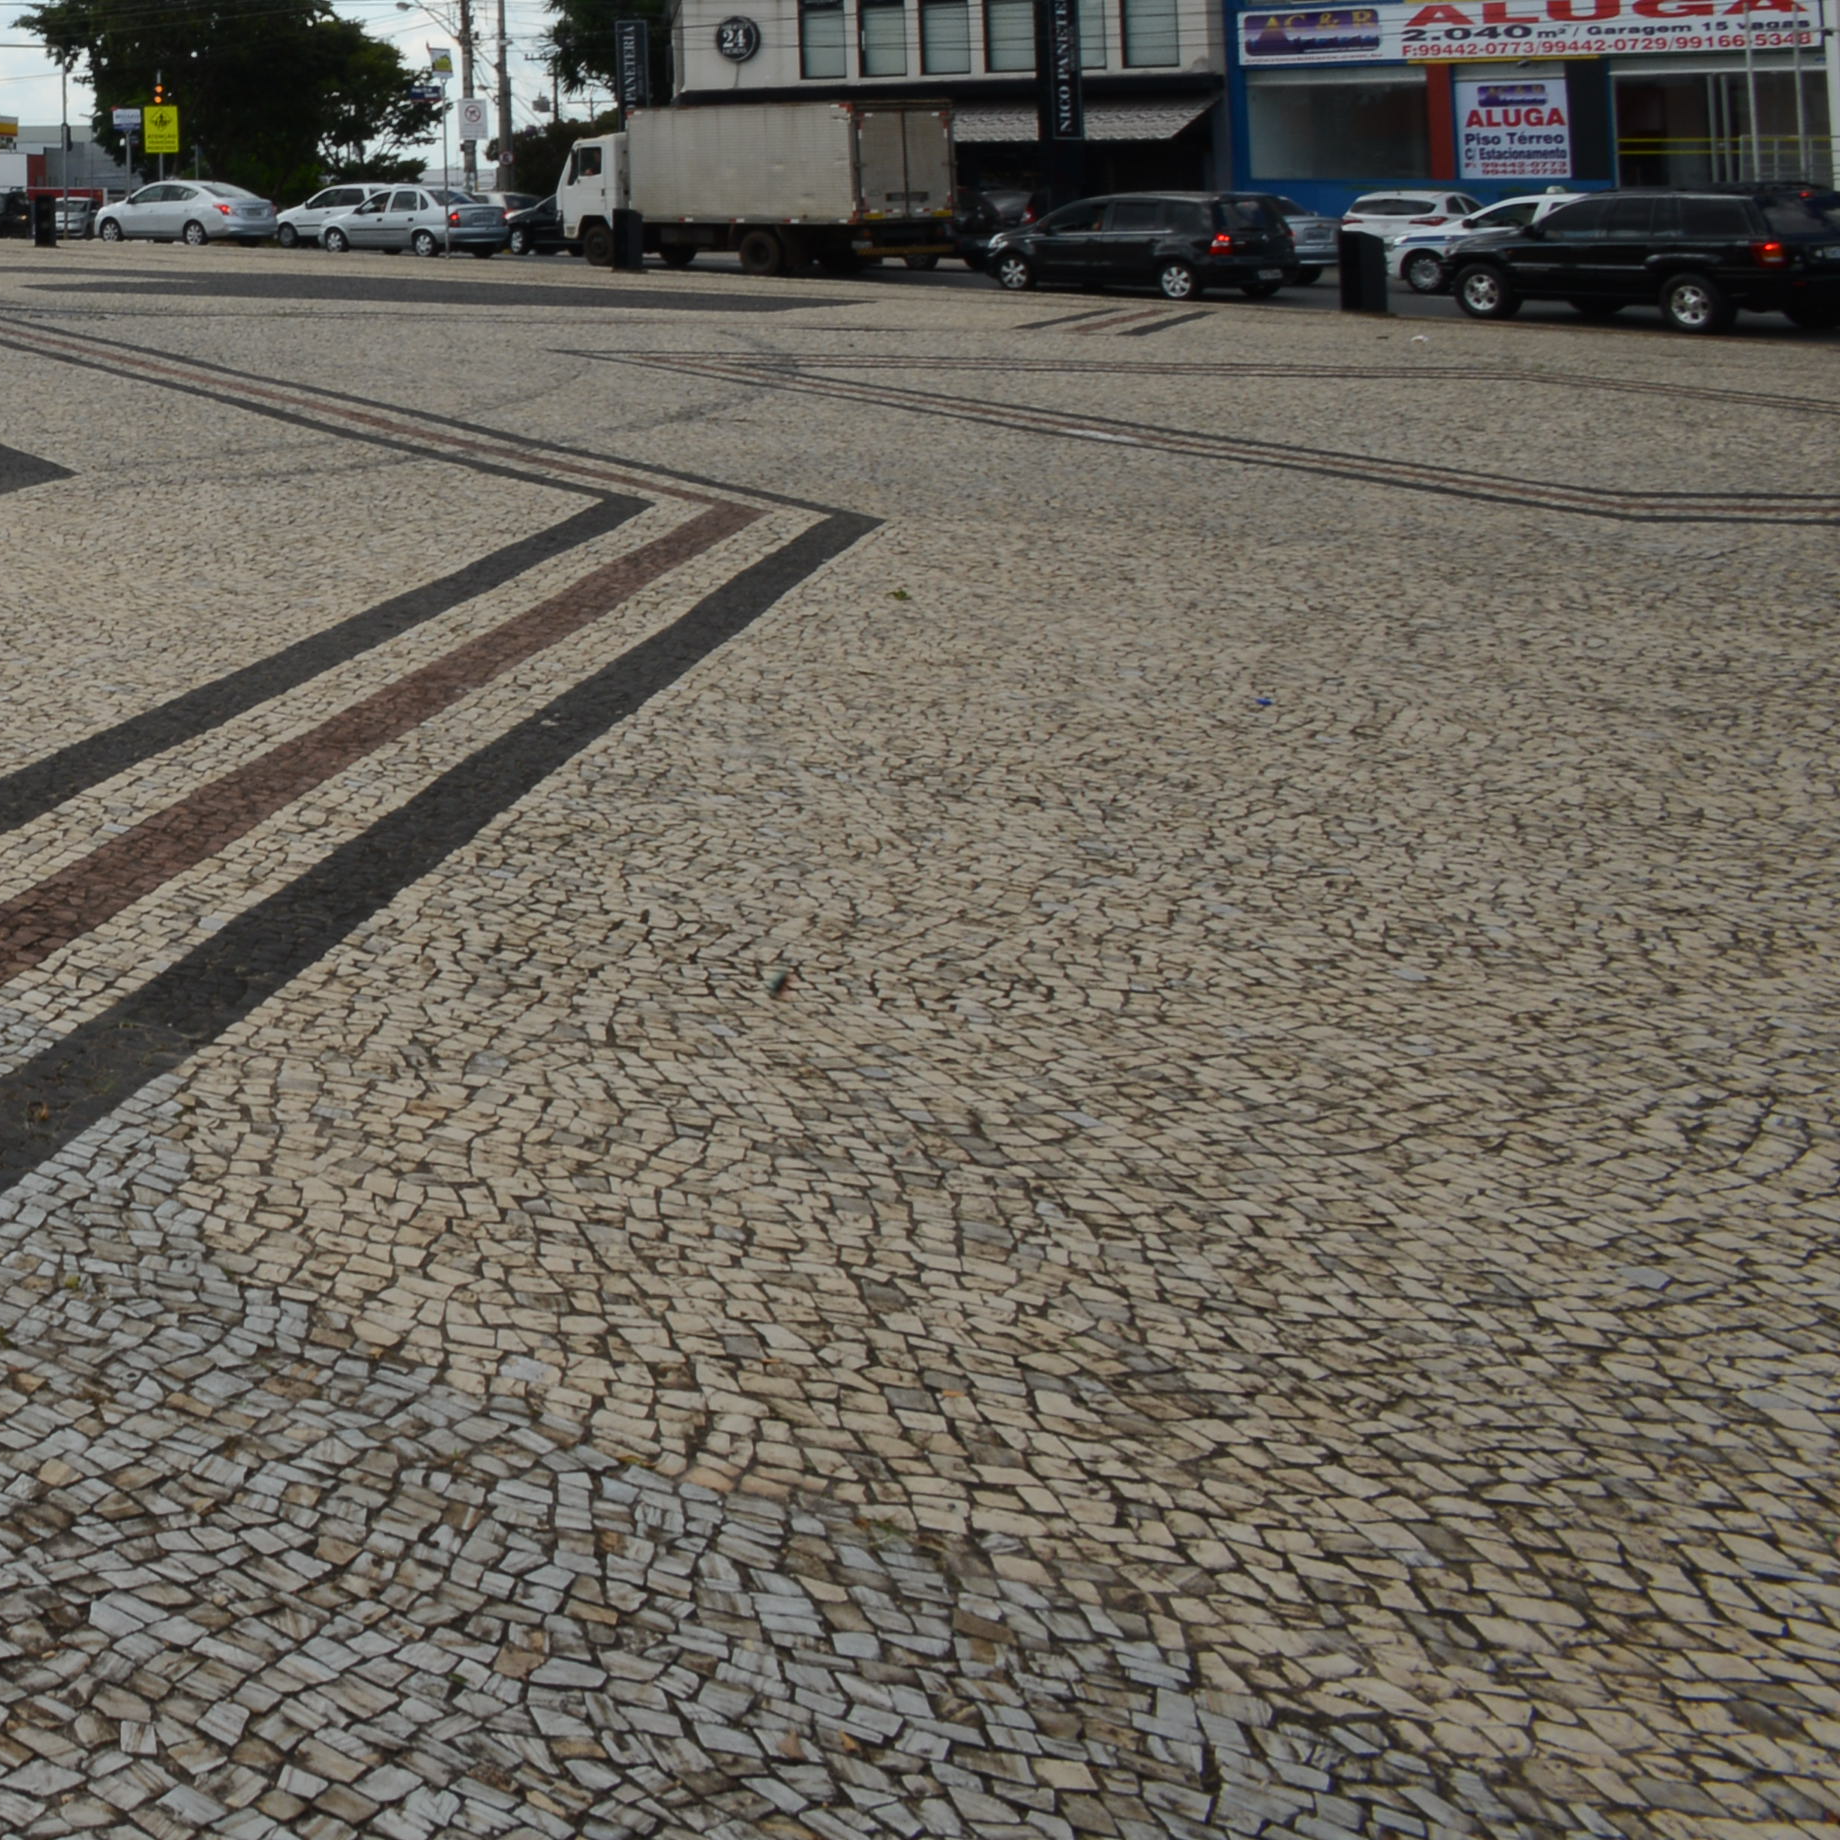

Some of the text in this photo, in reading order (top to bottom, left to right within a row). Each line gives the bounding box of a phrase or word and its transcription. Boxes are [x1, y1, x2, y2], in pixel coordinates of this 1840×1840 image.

[1586, 23, 1692, 36] Garagem
[1702, 21, 1728, 32] 15
[1737, 19, 1811, 33] vagas
[722, 29, 746, 48] 24
[623, 26, 636, 101] PANETERIA
[1059, 85, 1072, 132] NICO
[1465, 107, 1566, 128] ALUGA
[1465, 131, 1564, 145] Piso Térreo
[1479, 147, 1567, 160] Estacionamento
